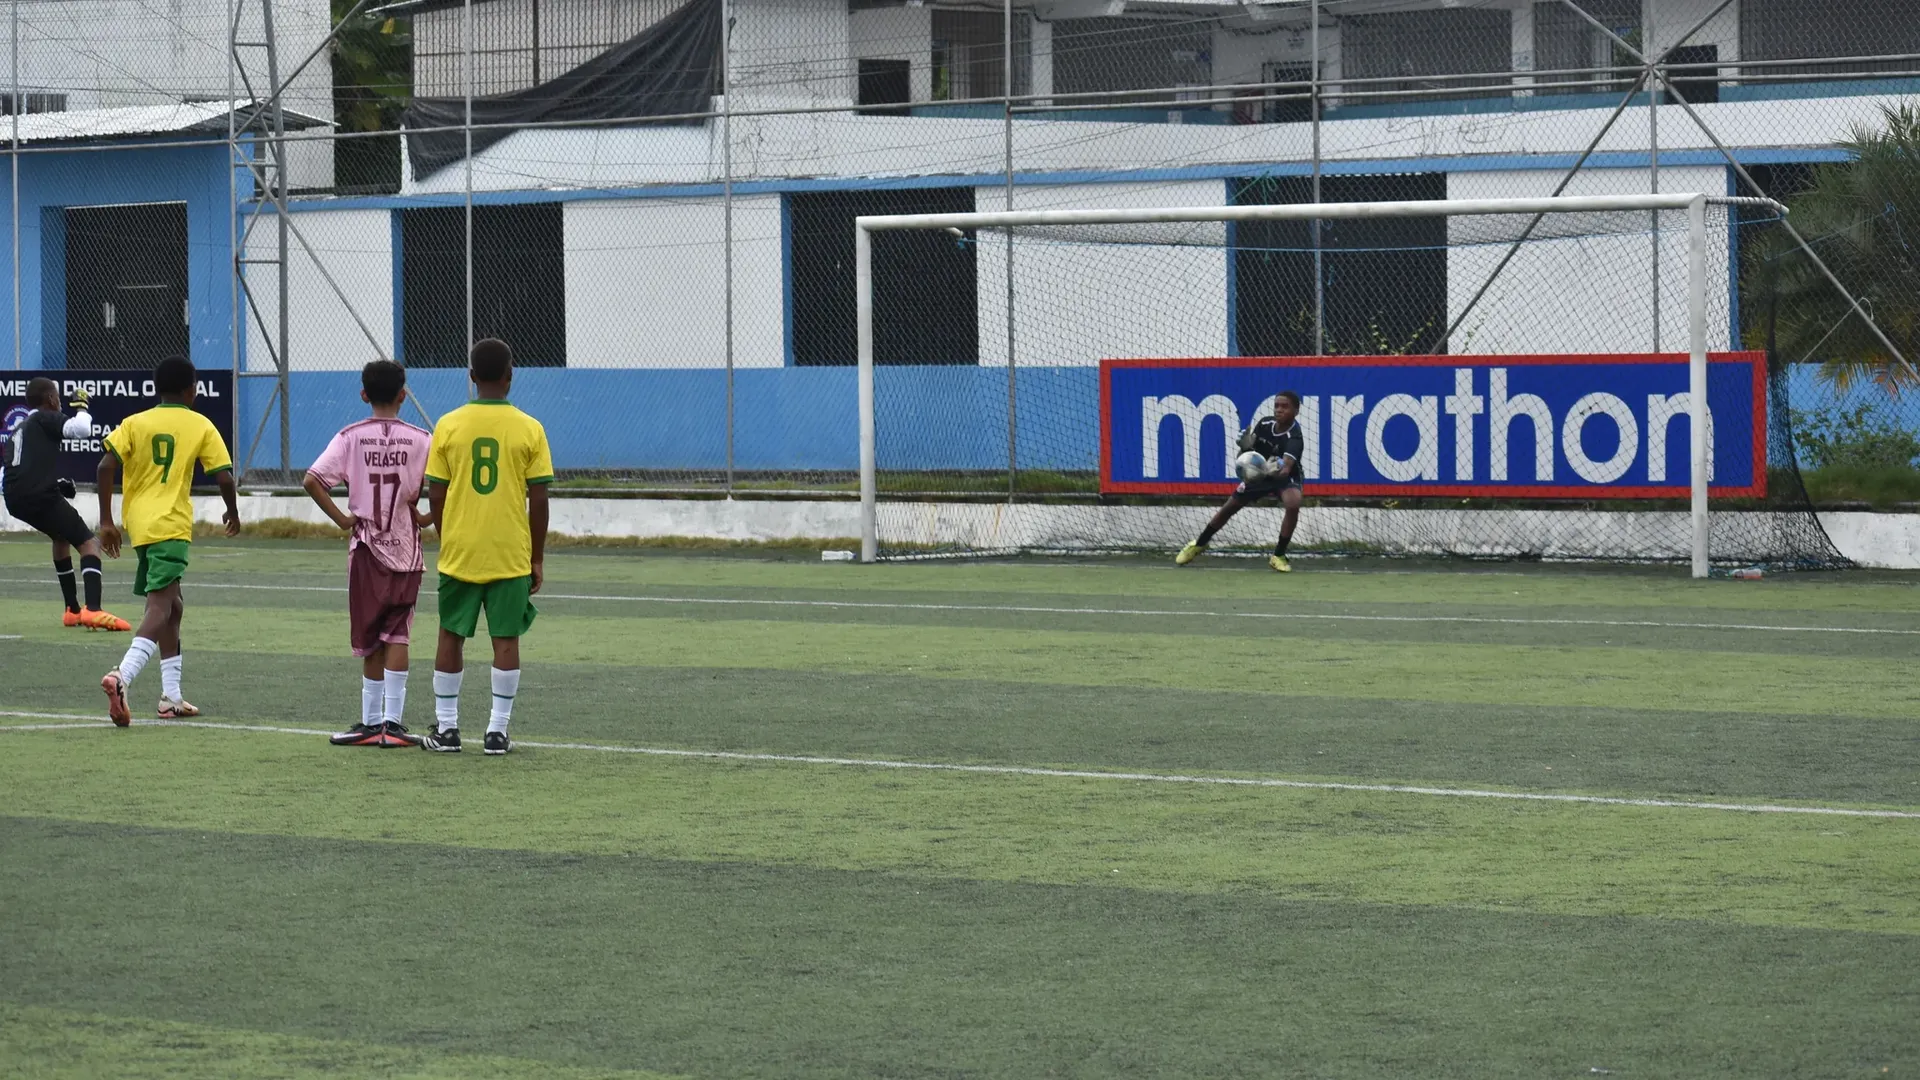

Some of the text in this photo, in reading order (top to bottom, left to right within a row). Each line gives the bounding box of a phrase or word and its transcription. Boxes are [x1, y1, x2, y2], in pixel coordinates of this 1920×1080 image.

[1141, 367, 1714, 484] marathon
[151, 433, 175, 484] 9
[364, 451, 408, 467] VELASCO
[471, 437, 499, 495] 8
[369, 473, 402, 532] 17
